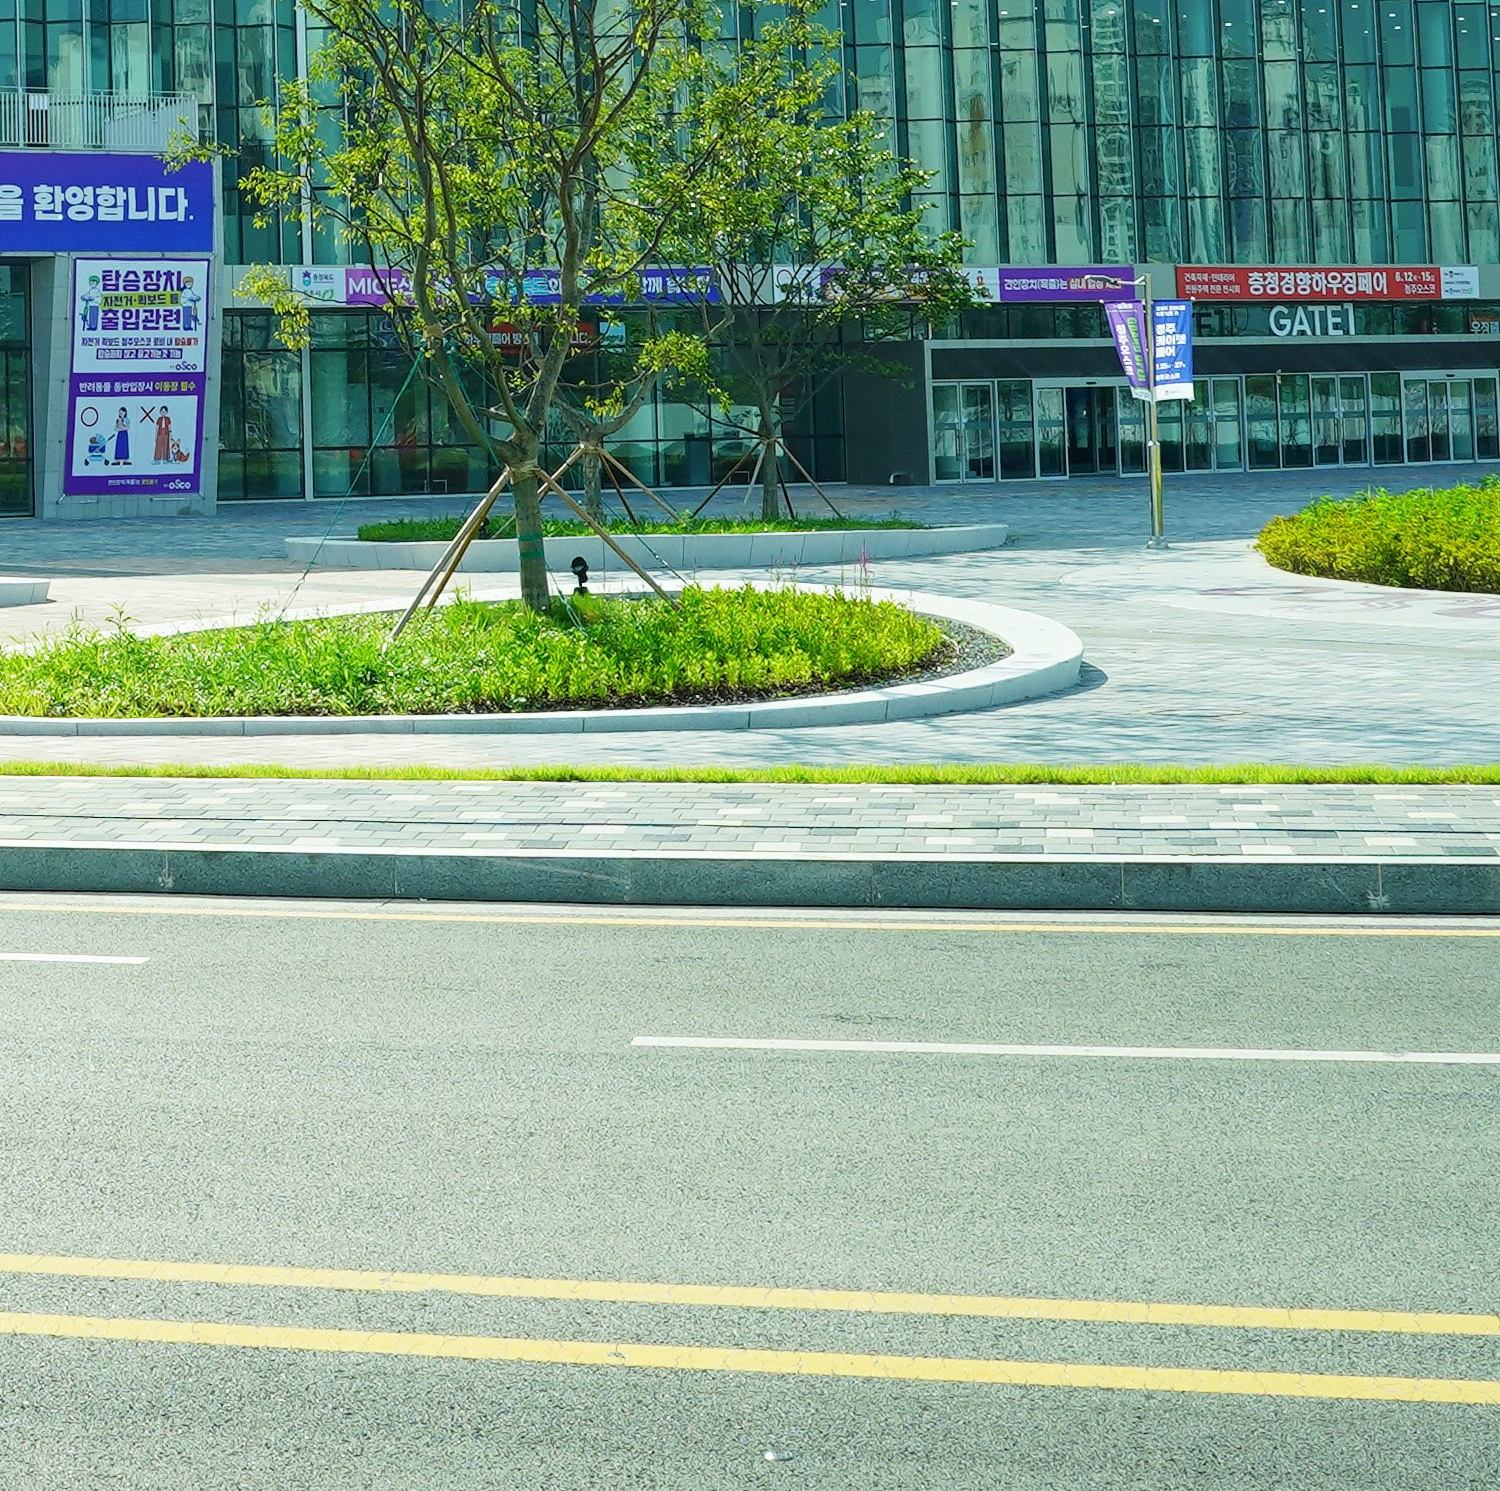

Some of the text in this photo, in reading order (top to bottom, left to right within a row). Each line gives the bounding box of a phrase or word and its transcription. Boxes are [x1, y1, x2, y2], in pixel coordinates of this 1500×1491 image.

[32, 184, 194, 221] 환영합니다.
[101, 270, 182, 292] 탑승장치
[1247, 271, 1387, 296] 충청경향하우징페어
[101, 309, 180, 330] 출입관련
